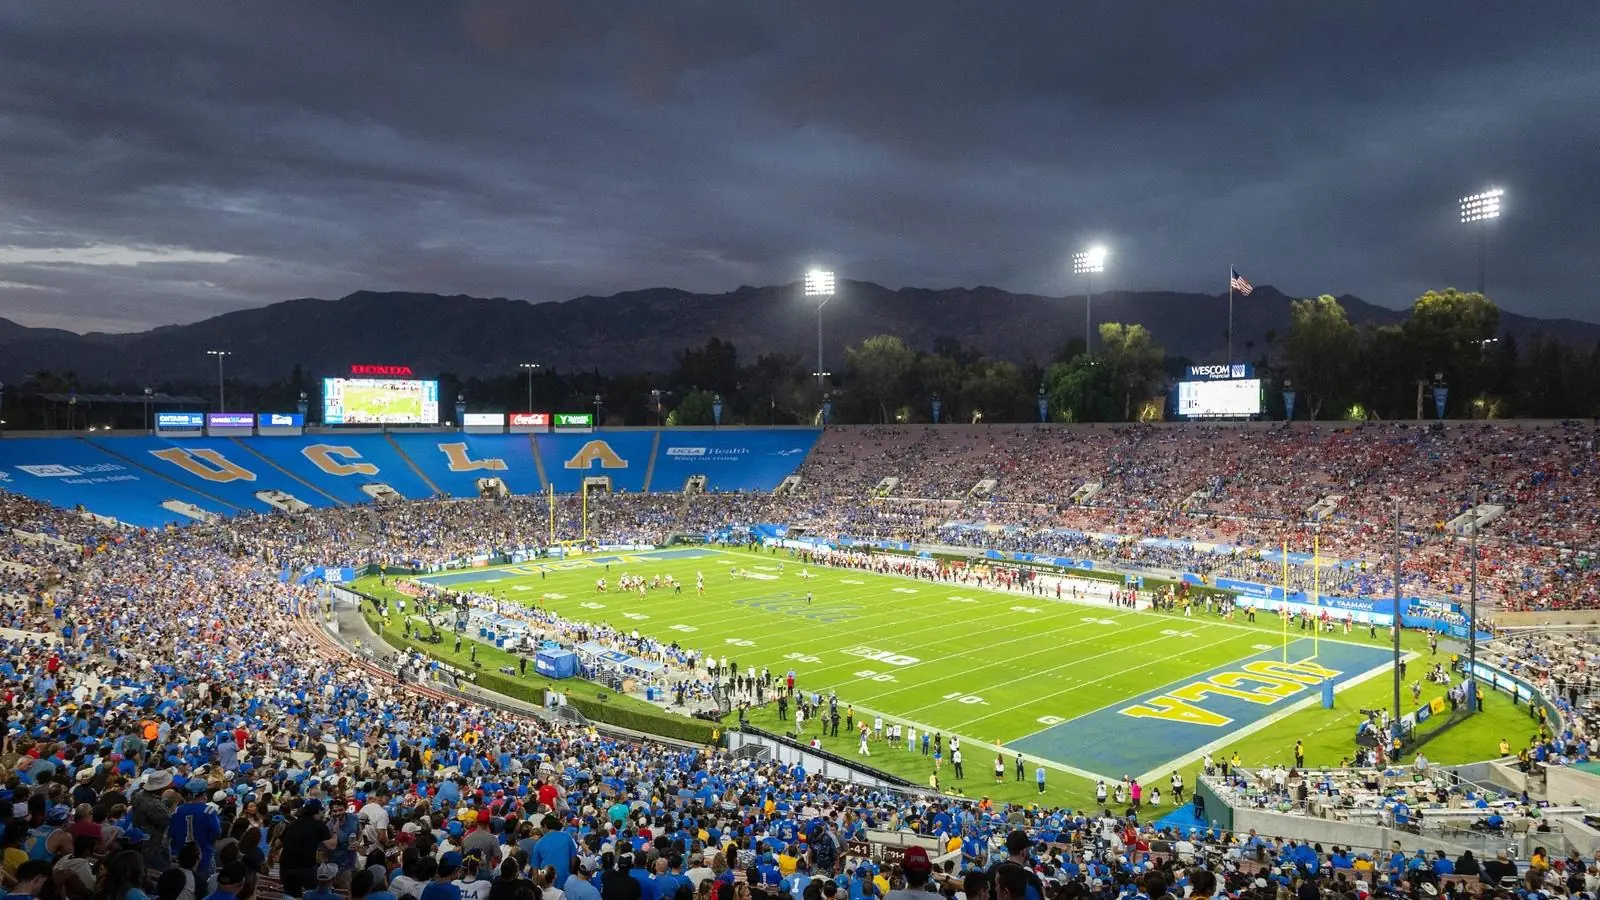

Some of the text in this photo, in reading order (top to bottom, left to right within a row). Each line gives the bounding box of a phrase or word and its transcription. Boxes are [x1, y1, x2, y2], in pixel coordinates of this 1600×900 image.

[351, 365, 412, 376] HONDA
[1192, 365, 1230, 375] WESCOM
[708, 447, 750, 455] Health
[853, 670, 896, 682] 20
[941, 692, 984, 705] 10
[1117, 660, 1344, 727] UCLA
[1036, 715, 1066, 725] G
[185, 814, 195, 843] 1
[791, 877, 800, 893] 1
[460, 889, 478, 899] CLA
